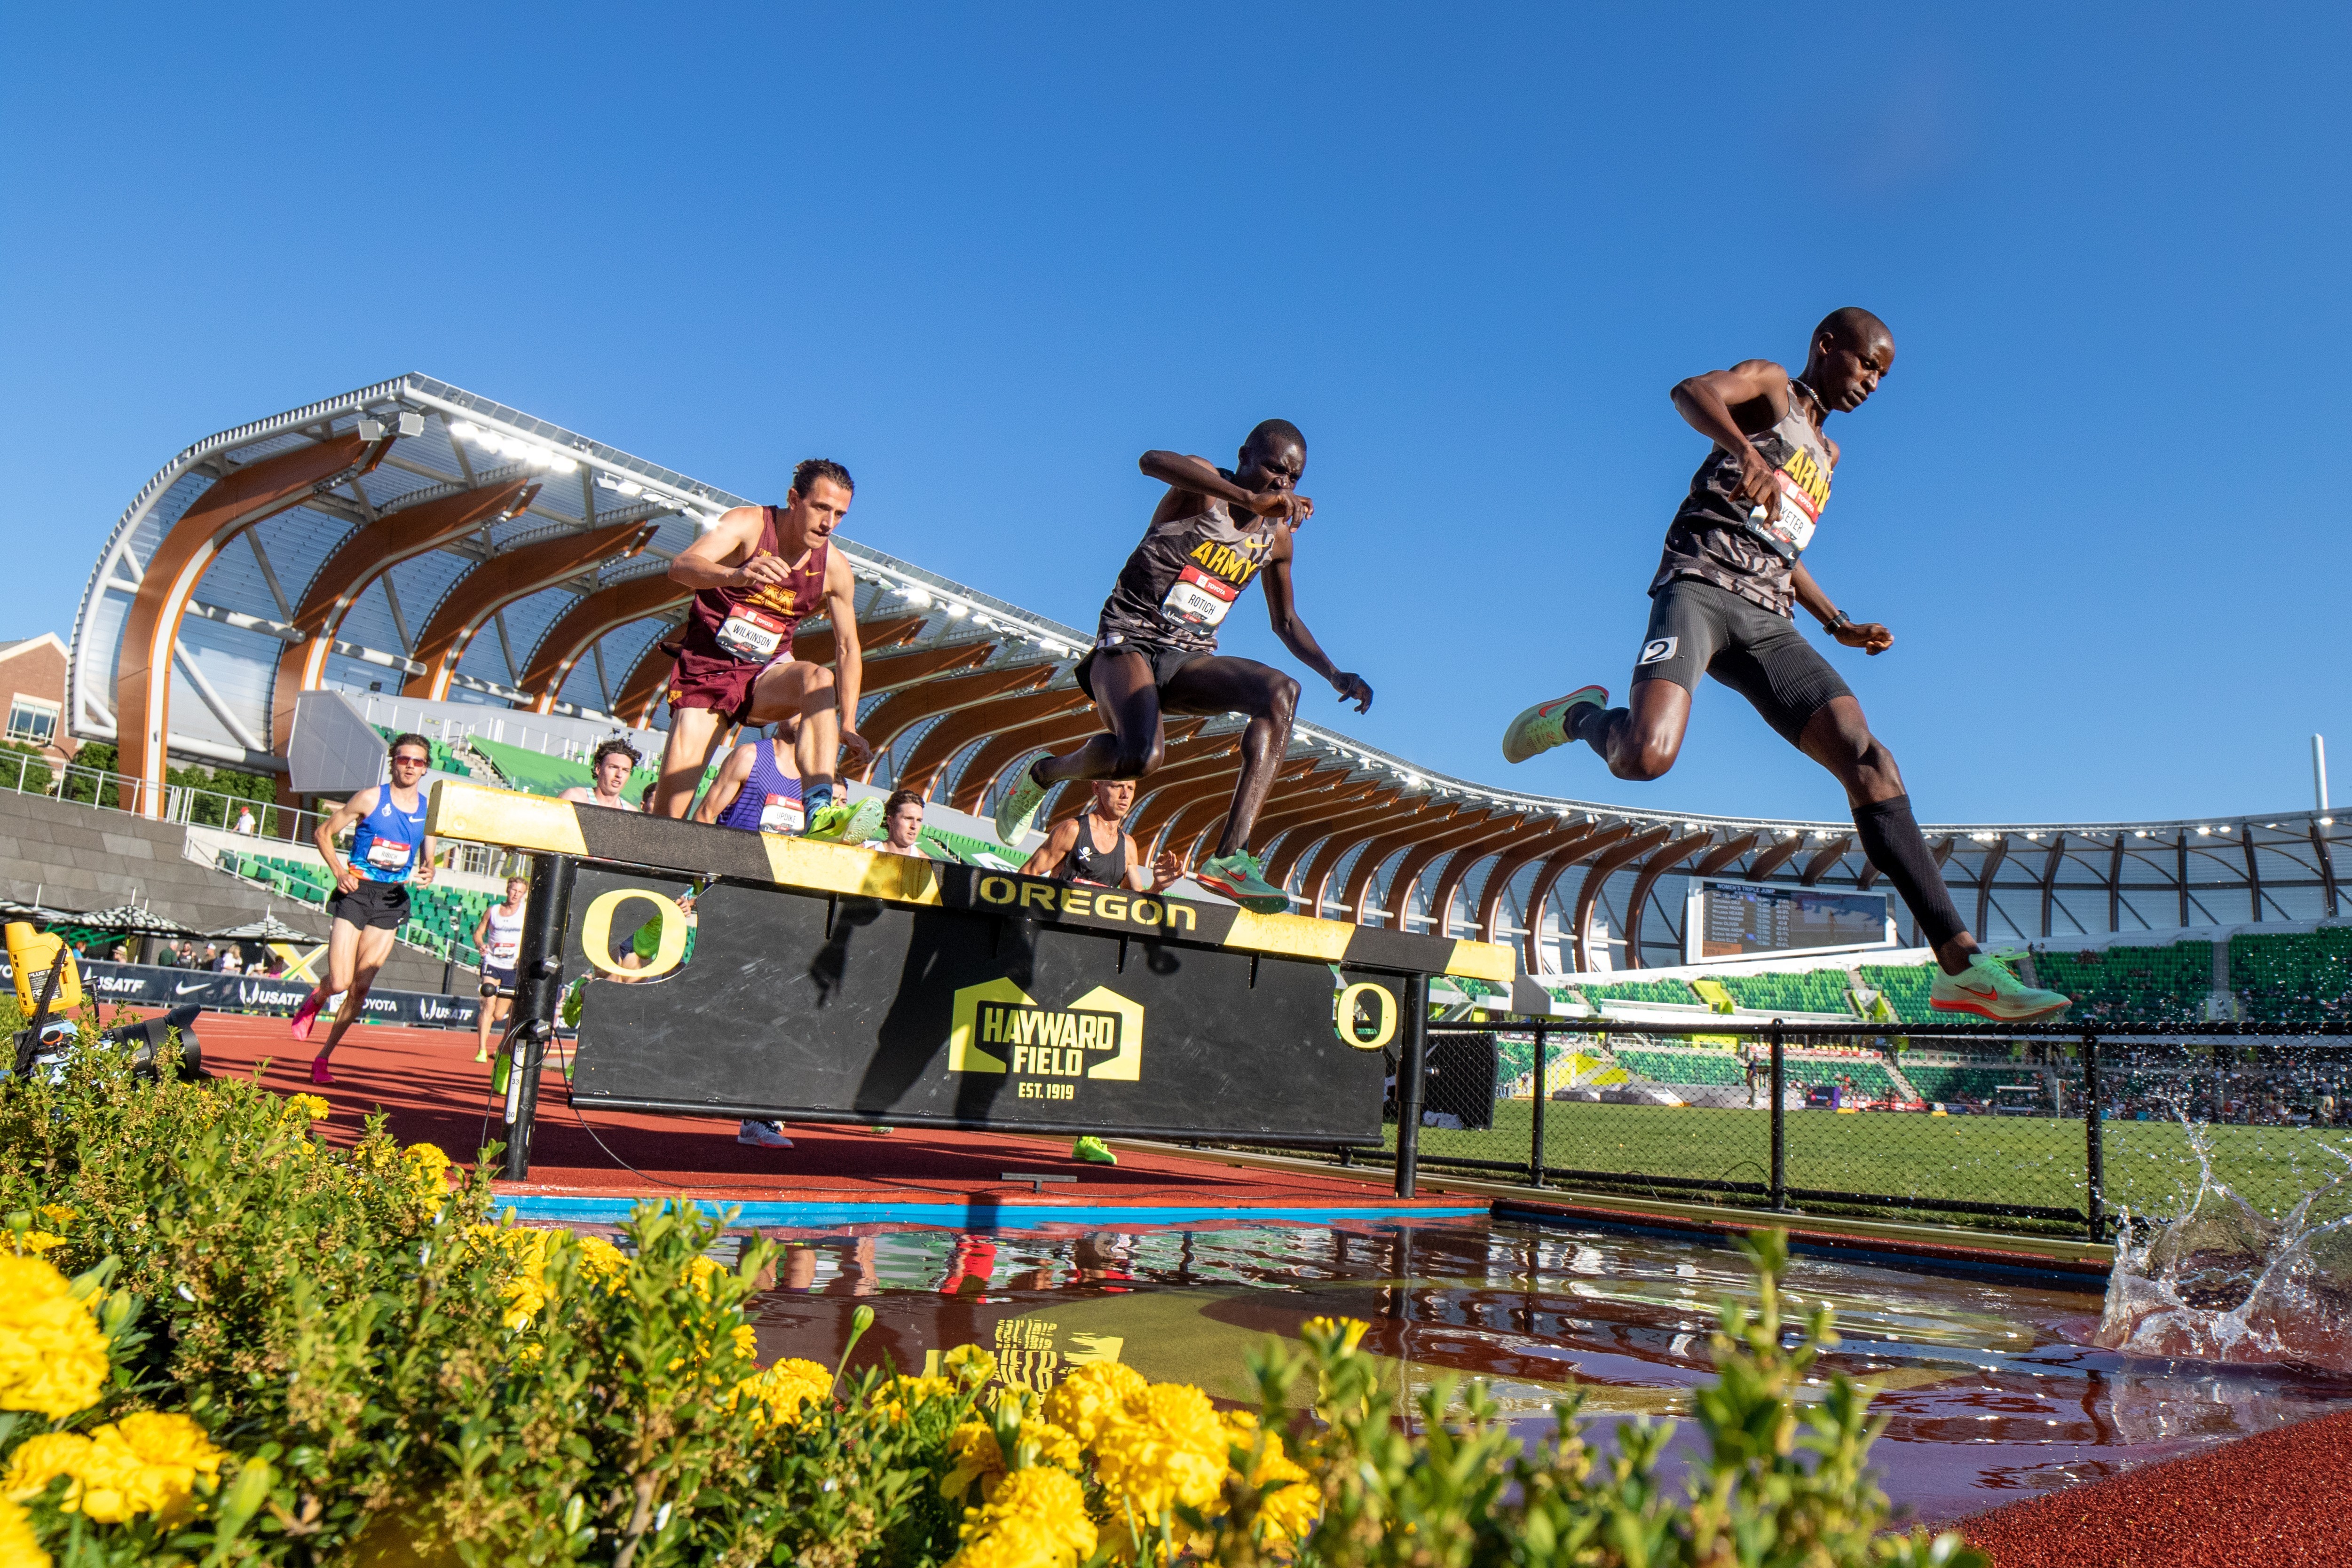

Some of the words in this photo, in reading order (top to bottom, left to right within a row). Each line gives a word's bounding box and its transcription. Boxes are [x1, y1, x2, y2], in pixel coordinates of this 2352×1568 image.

[1783, 446, 1831, 513] ARMY
[1798, 494, 1814, 513] TOYOTA
[1190, 540, 1258, 584] ARMY
[1207, 583, 1225, 596] TOYOTA
[1188, 594, 1216, 615] ROTICH
[756, 617, 774, 628] TOYOTA
[733, 624, 772, 647] WILKINSON
[776, 812, 797, 823] UPDIKE
[979, 876, 1196, 931] OREGON
[582, 889, 687, 977] O
[259, 991, 305, 1006] USATF
[362, 998, 397, 1011] OYOTA
[436, 1006, 473, 1021] USATF
[1338, 982, 1397, 1048] O
[983, 1007, 1115, 1050] HAYWARD
[1013, 1045, 1083, 1076] FIELD
[1018, 1082, 1043, 1099] EST.
[1046, 1084, 1074, 1099] 1919
